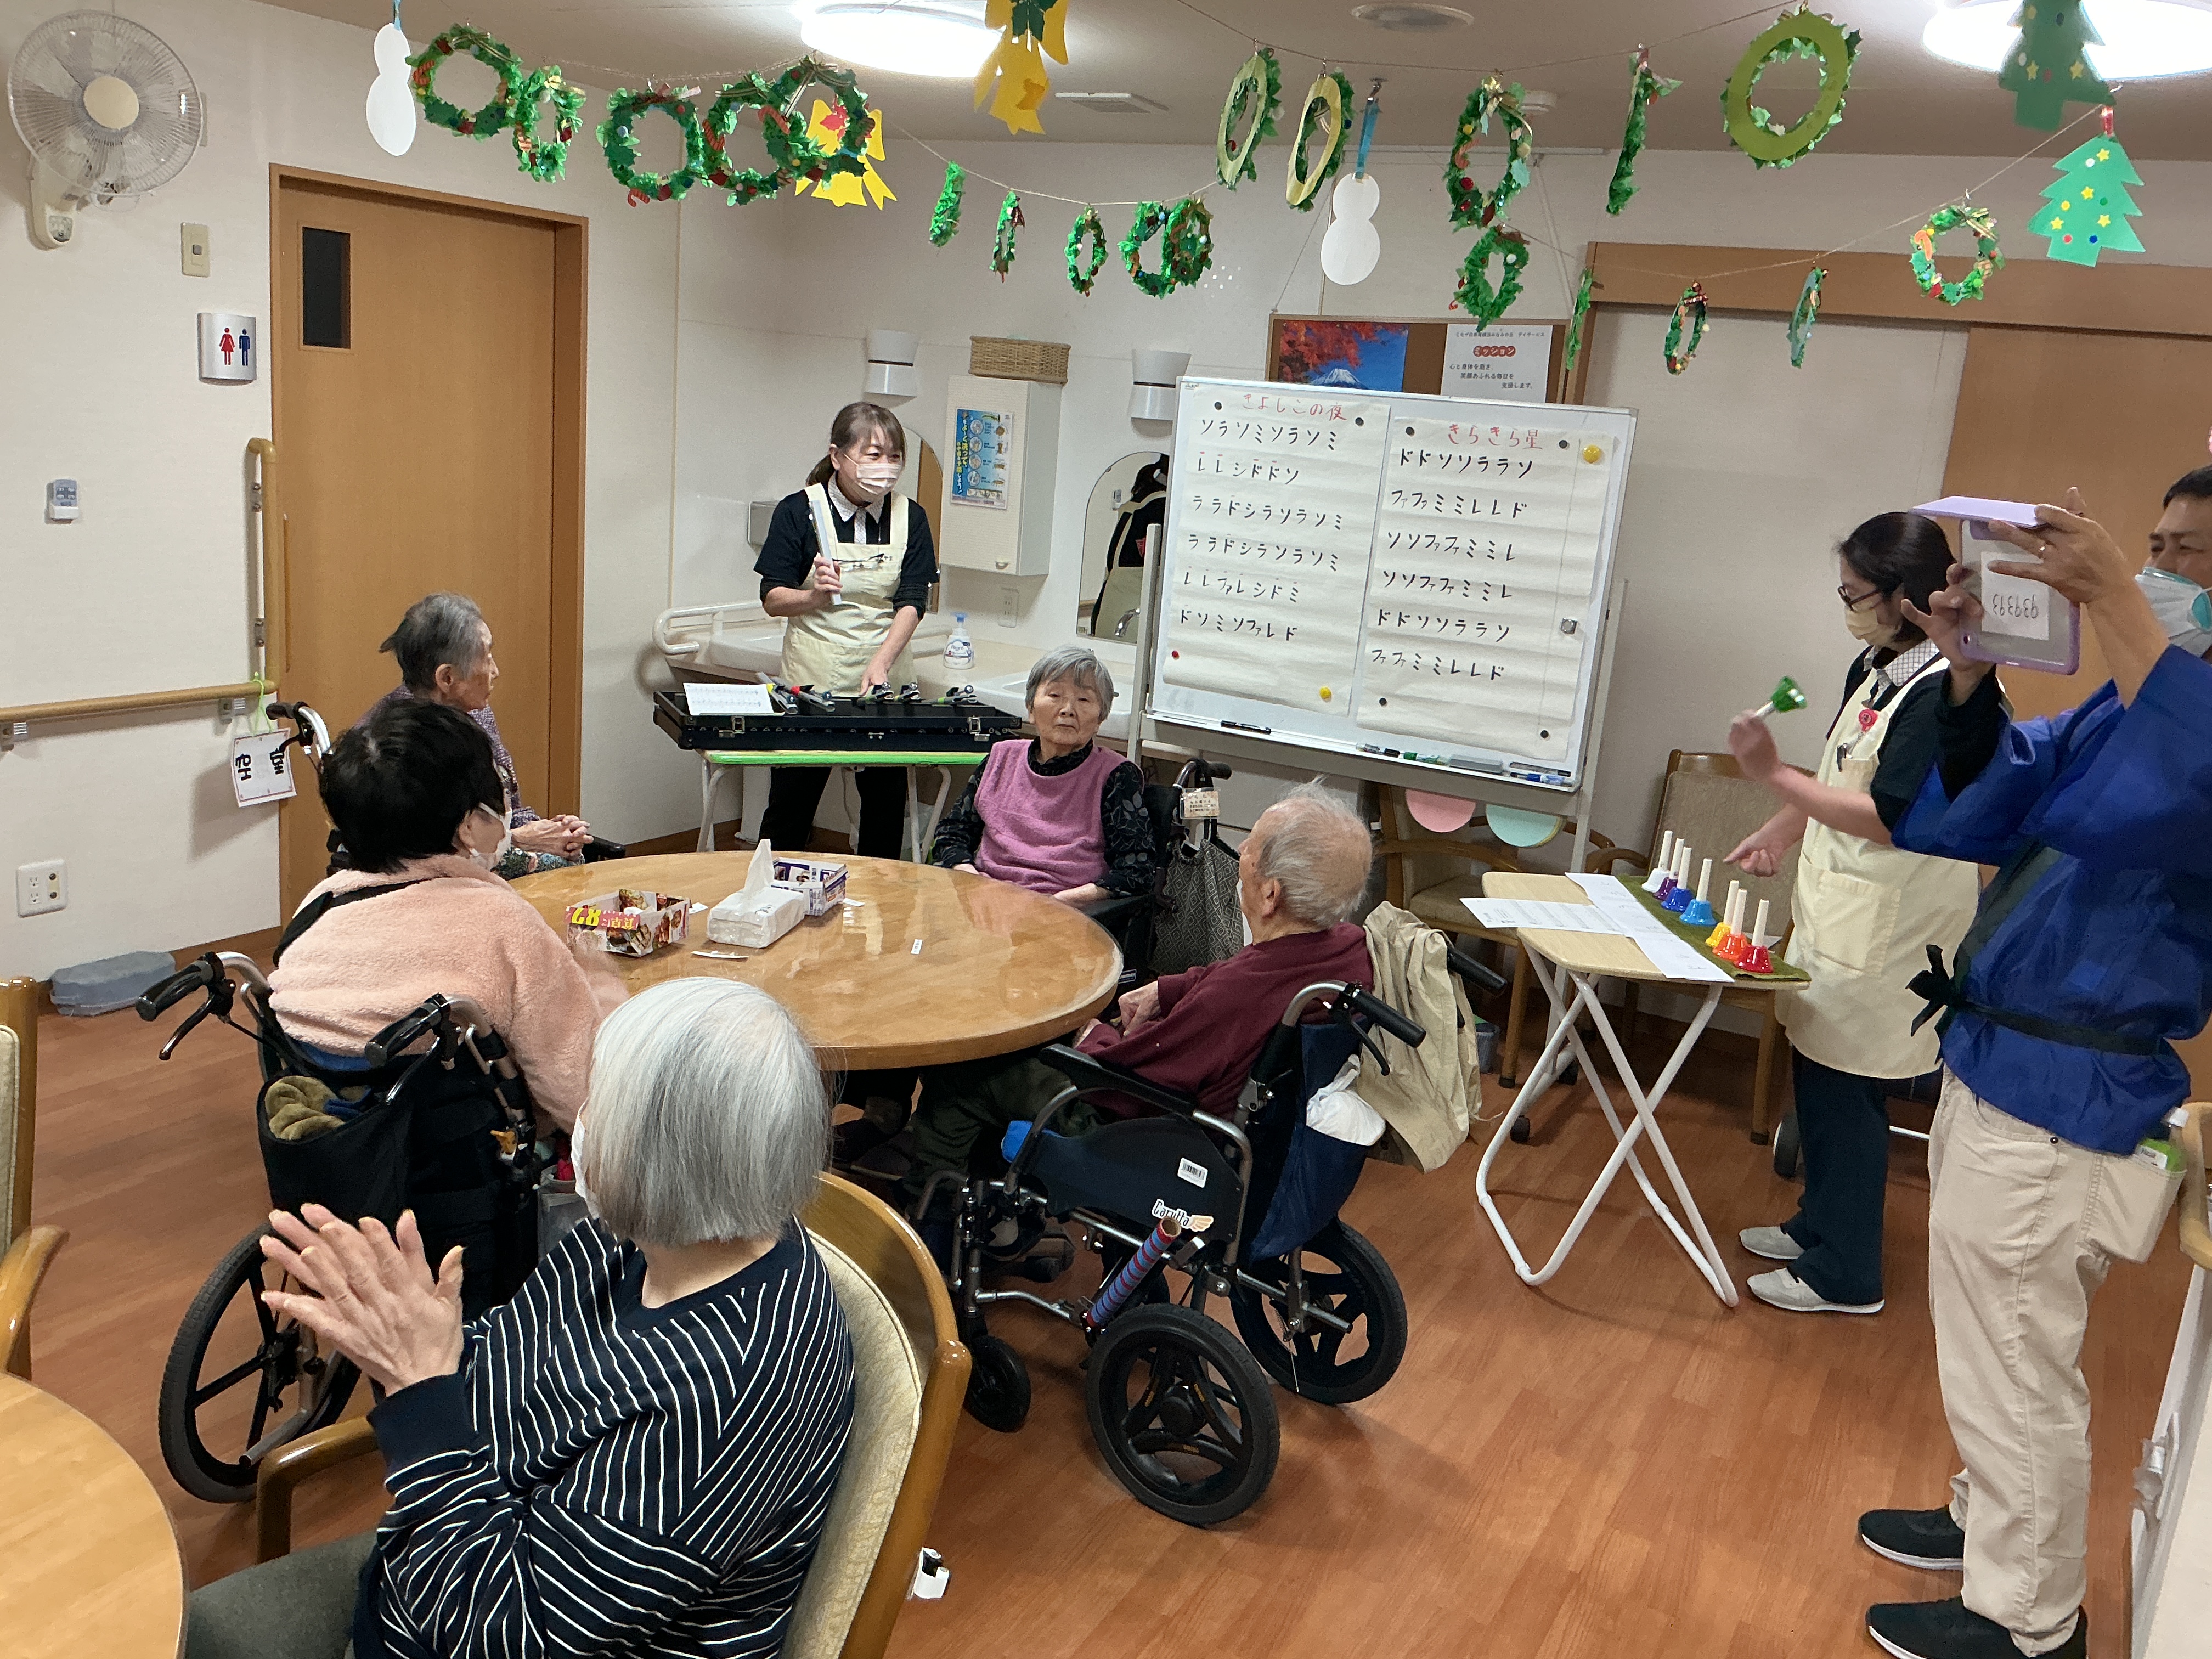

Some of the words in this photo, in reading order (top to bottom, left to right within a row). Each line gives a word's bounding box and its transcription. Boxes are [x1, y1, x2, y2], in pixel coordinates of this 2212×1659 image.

[1474, 346, 1516, 357] ミッション
[1244, 393, 1347, 421] きよしこの夜
[1201, 419, 1338, 451] ソラソミソラソミ
[1448, 423, 1543, 450] きらきら星
[1198, 458, 1299, 485] レレシドドソ
[1400, 448, 1533, 479] ドドソソララソ
[1193, 495, 1342, 531] ララドシラソラソミ
[1391, 490, 1527, 518] ファファミミレレド
[1188, 533, 1338, 572] ララドシラソラソミ
[1387, 532, 1516, 561] ソソファファミミレ
[1184, 571, 1299, 603] レレファレシドミ
[1383, 571, 1513, 601] ソソファファミミレ
[1993, 594, 2039, 619] 939393
[1181, 609, 1297, 641] ドソミソファレド
[1378, 608, 1510, 642] ドドソソララソ
[1372, 649, 1504, 681] ファファミミレレド
